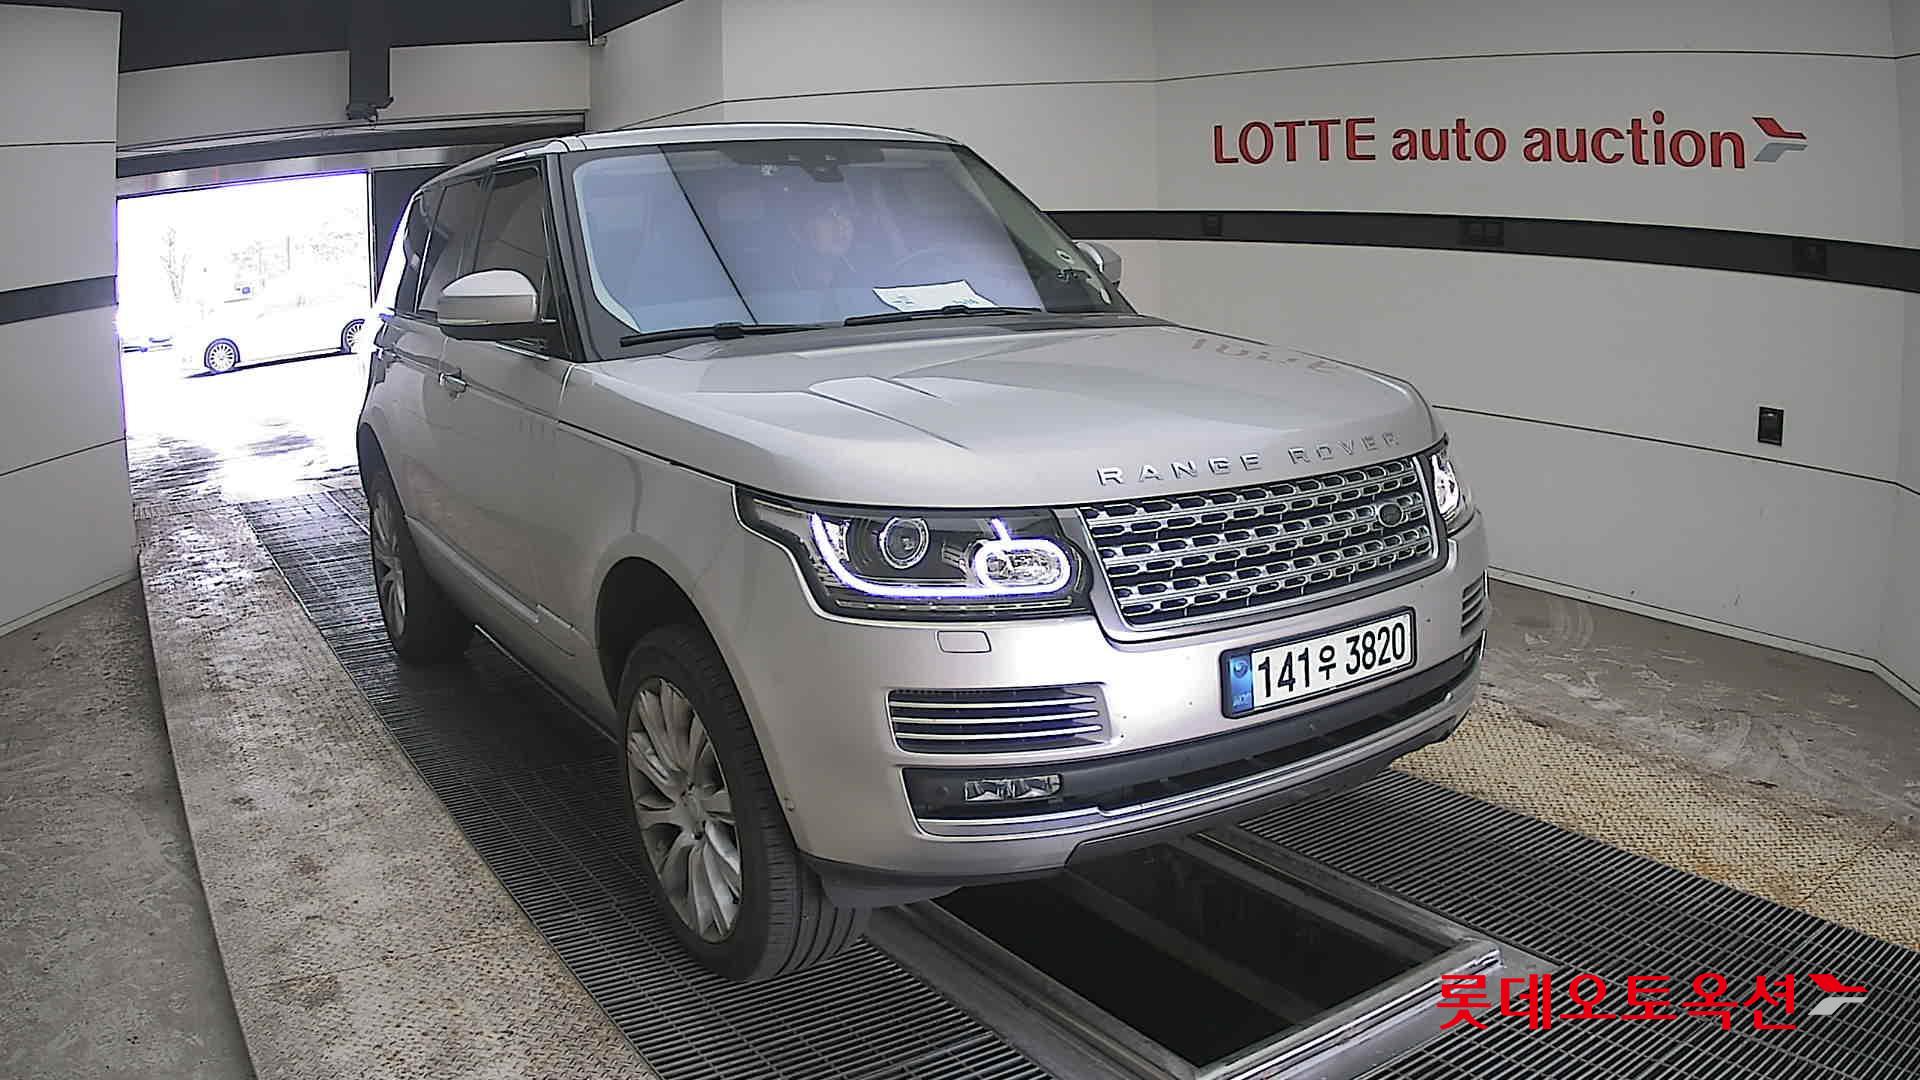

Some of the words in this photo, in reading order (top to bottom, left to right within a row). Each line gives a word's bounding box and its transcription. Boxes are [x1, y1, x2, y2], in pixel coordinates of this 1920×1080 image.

[1213, 117, 1376, 164] LOTTE
[1391, 117, 1506, 162] auto
[1522, 110, 1746, 169] auction
[1096, 451, 1263, 486] RANGE
[1287, 432, 1400, 465] ROVER
[1258, 645, 1336, 698] 141우
[1345, 622, 1405, 675] 3820
